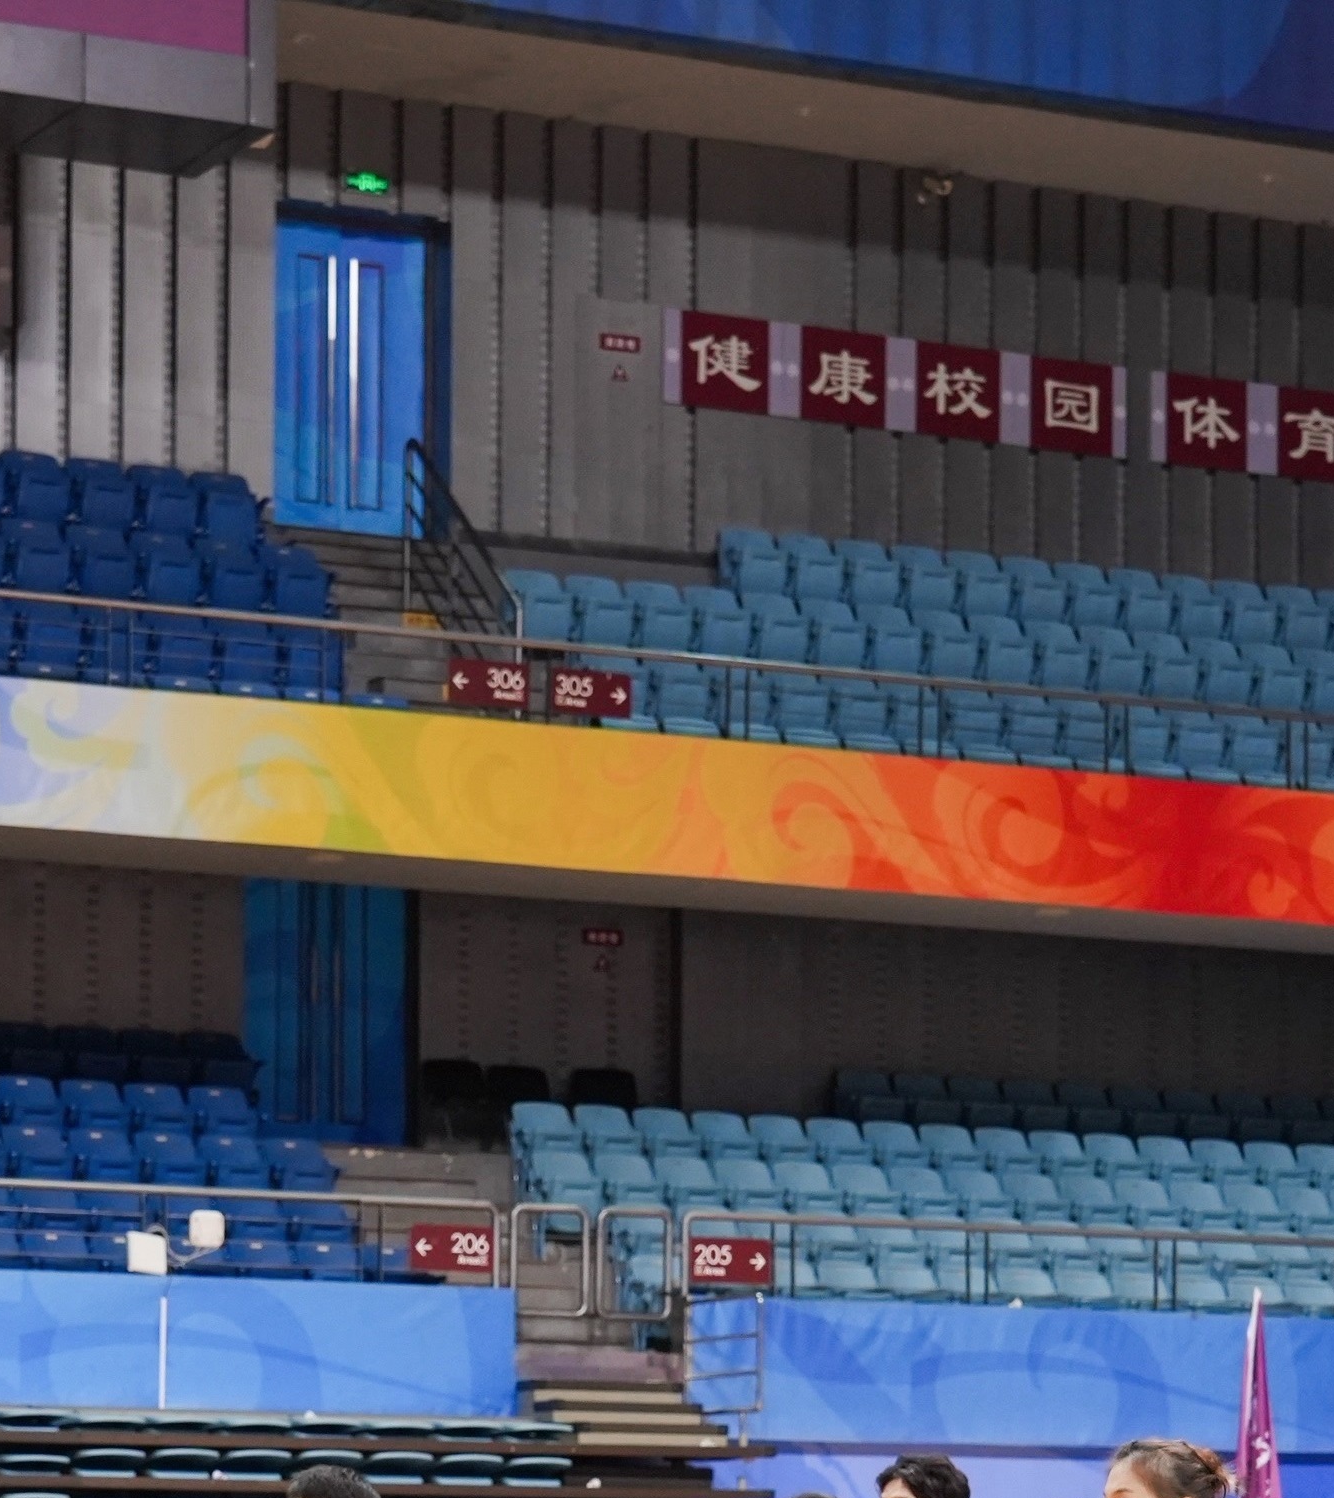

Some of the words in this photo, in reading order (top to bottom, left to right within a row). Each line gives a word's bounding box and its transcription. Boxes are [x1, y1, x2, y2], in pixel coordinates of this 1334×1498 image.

[688, 334, 1101, 434] 健康校园
[487, 667, 525, 690] 306
[555, 674, 593, 697] 305
[450, 1232, 490, 1255] 206
[694, 1244, 732, 1265] 205
